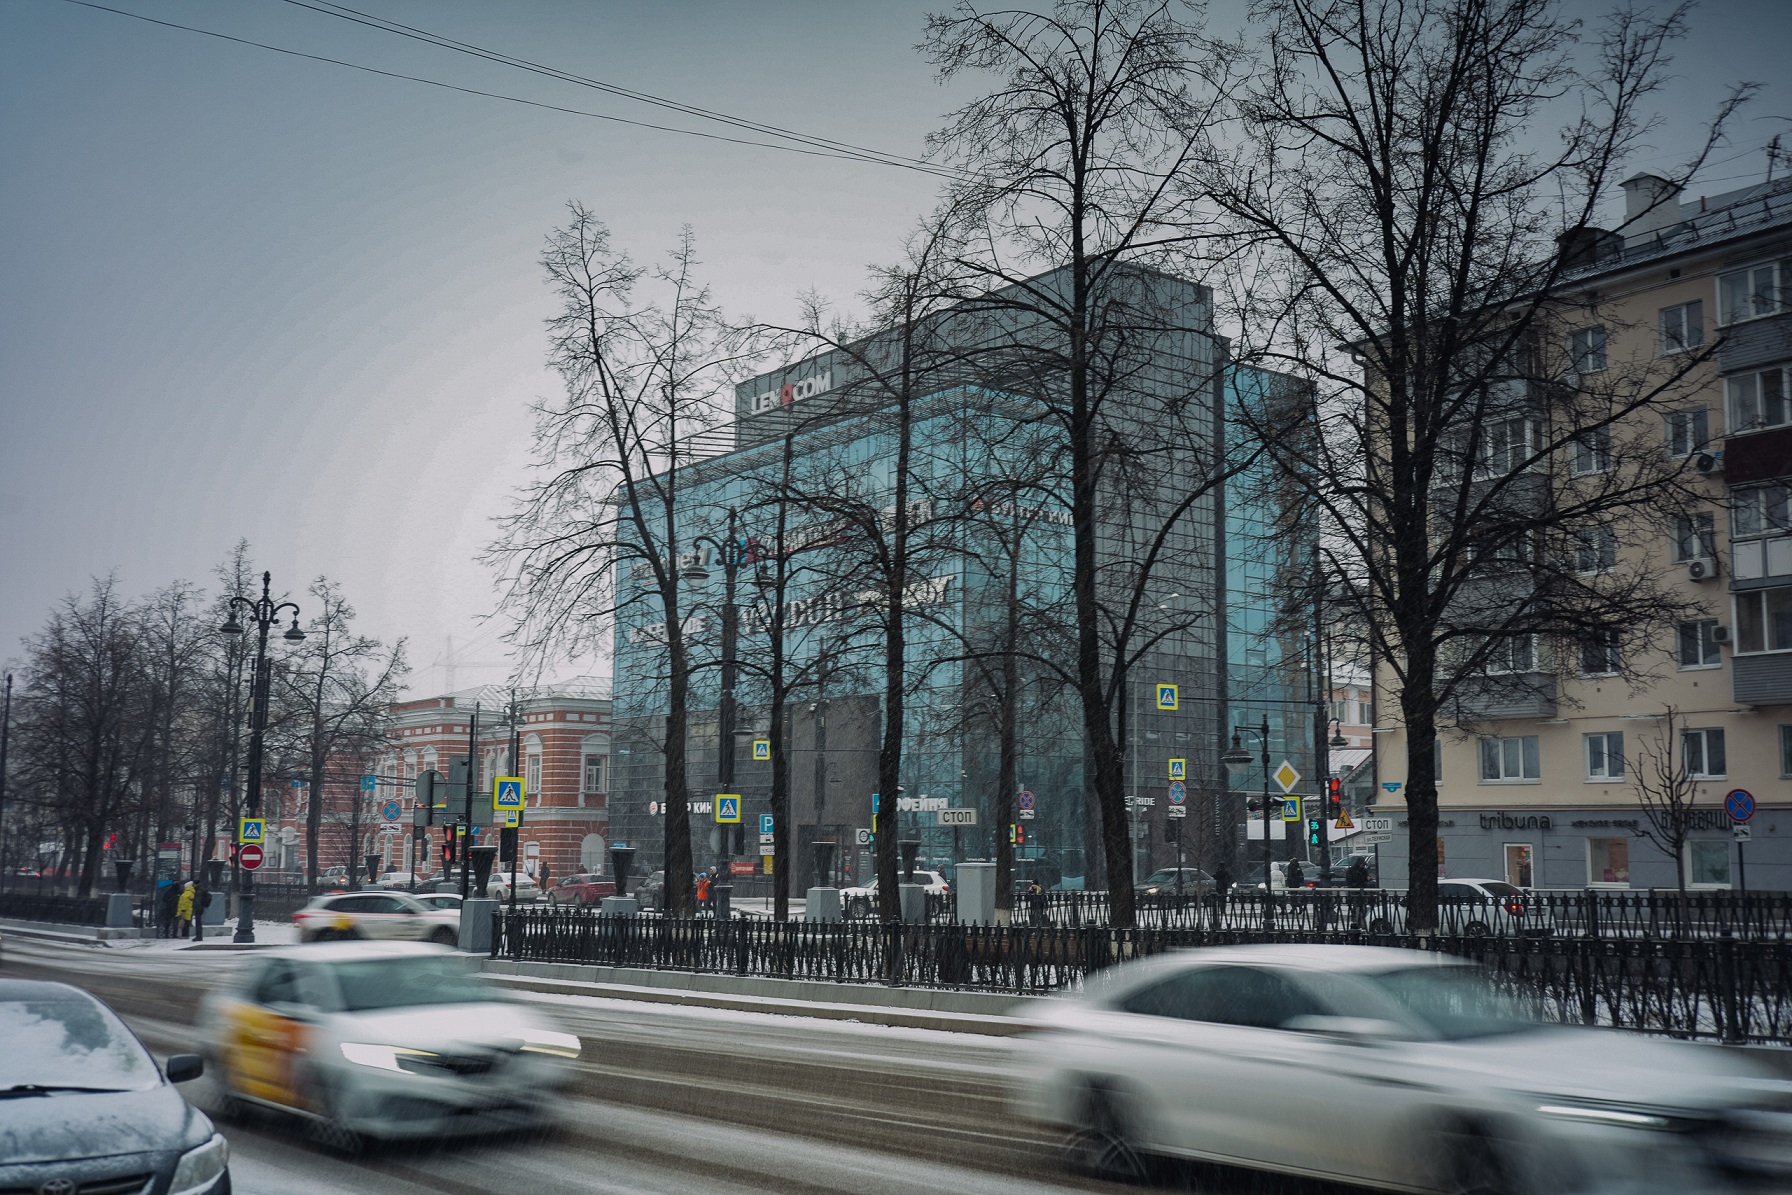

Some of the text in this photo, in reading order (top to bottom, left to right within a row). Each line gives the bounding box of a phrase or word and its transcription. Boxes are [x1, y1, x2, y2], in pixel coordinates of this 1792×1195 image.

[943, 811, 972, 823] СТОП
[1479, 811, 1552, 830] tribuna
[1366, 819, 1389, 830] СТОП
